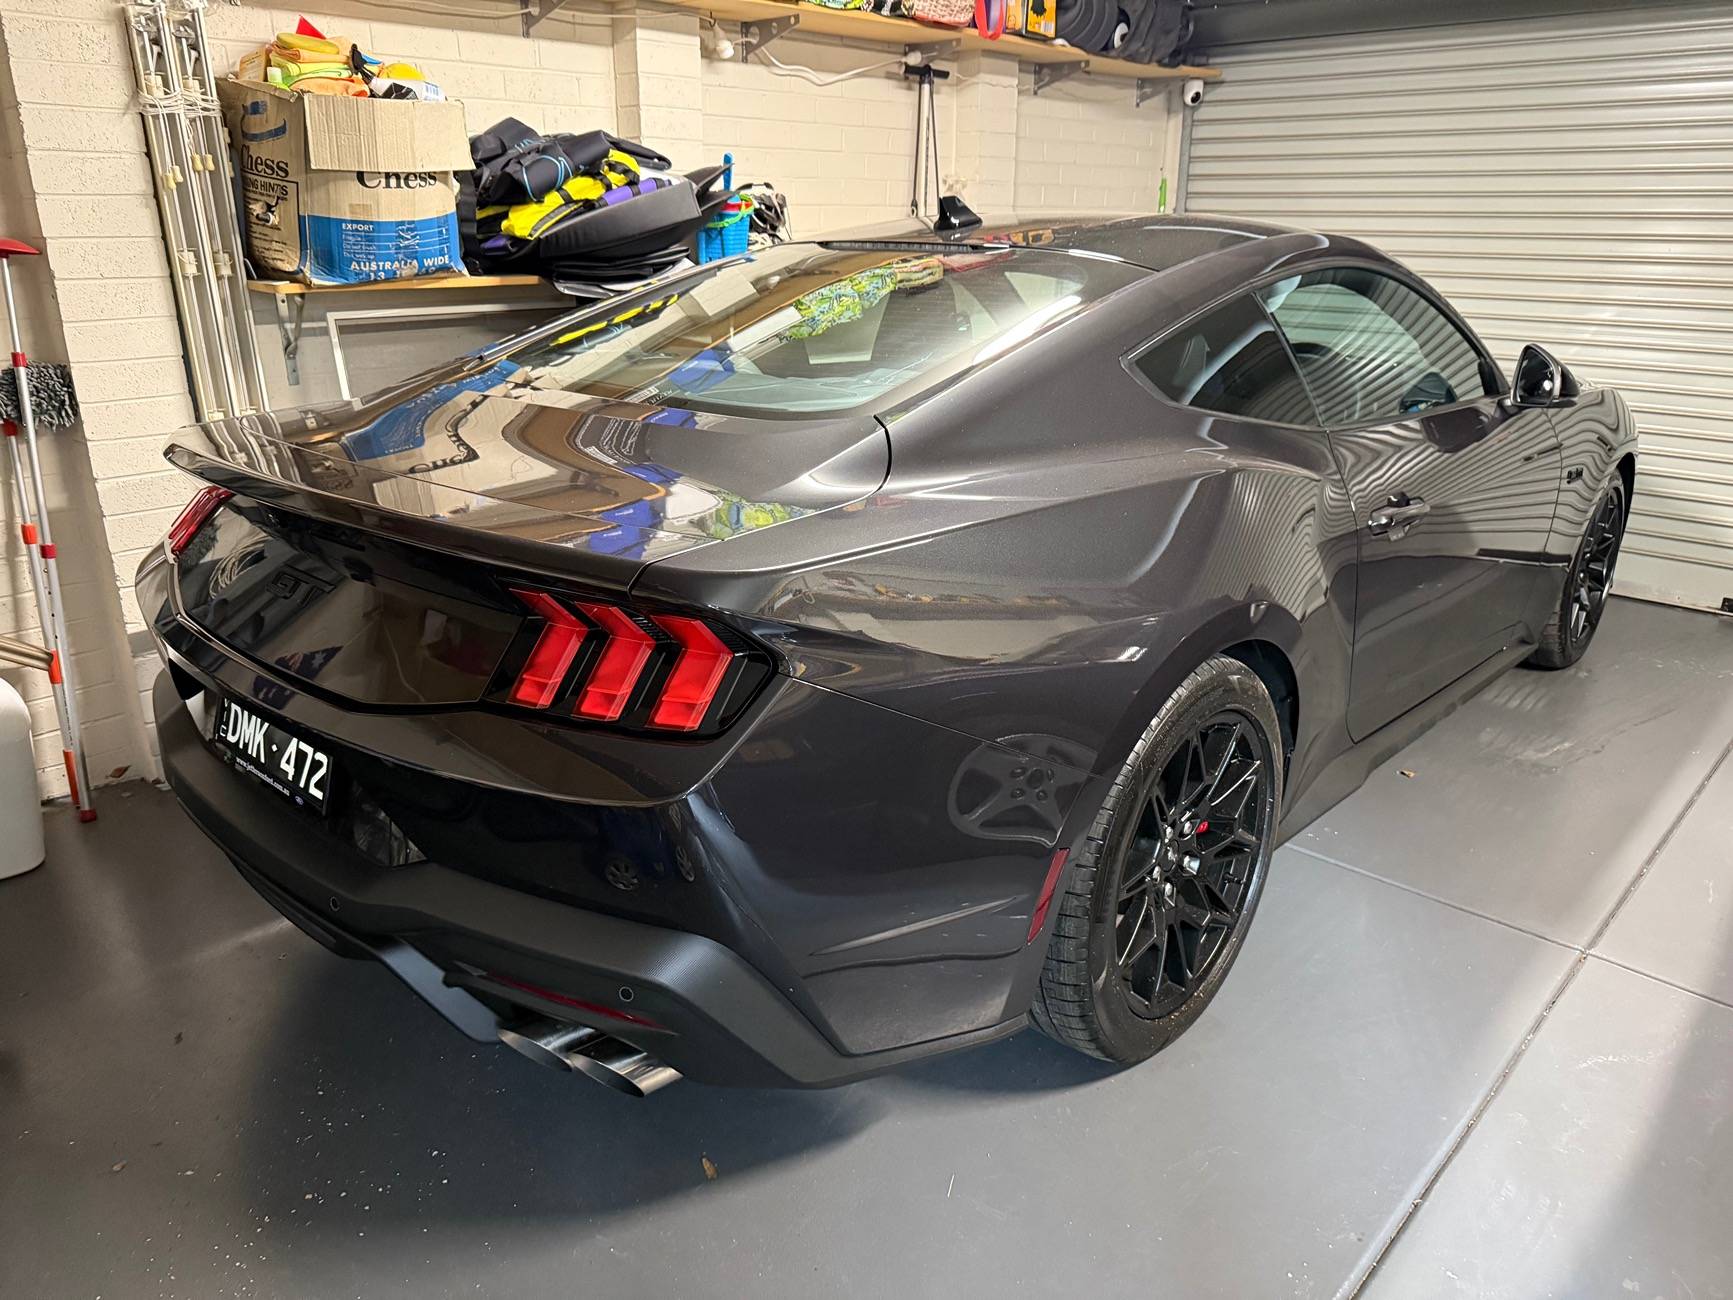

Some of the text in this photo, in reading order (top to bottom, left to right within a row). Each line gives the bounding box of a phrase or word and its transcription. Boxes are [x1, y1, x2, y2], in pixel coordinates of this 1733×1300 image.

[240, 144, 289, 178] Chess
[260, 180, 289, 196] HINTS
[342, 223, 374, 232] EXPORT
[423, 255, 449, 267] WIDE
[271, 564, 337, 608] GT
[227, 702, 328, 801] DMK 472
